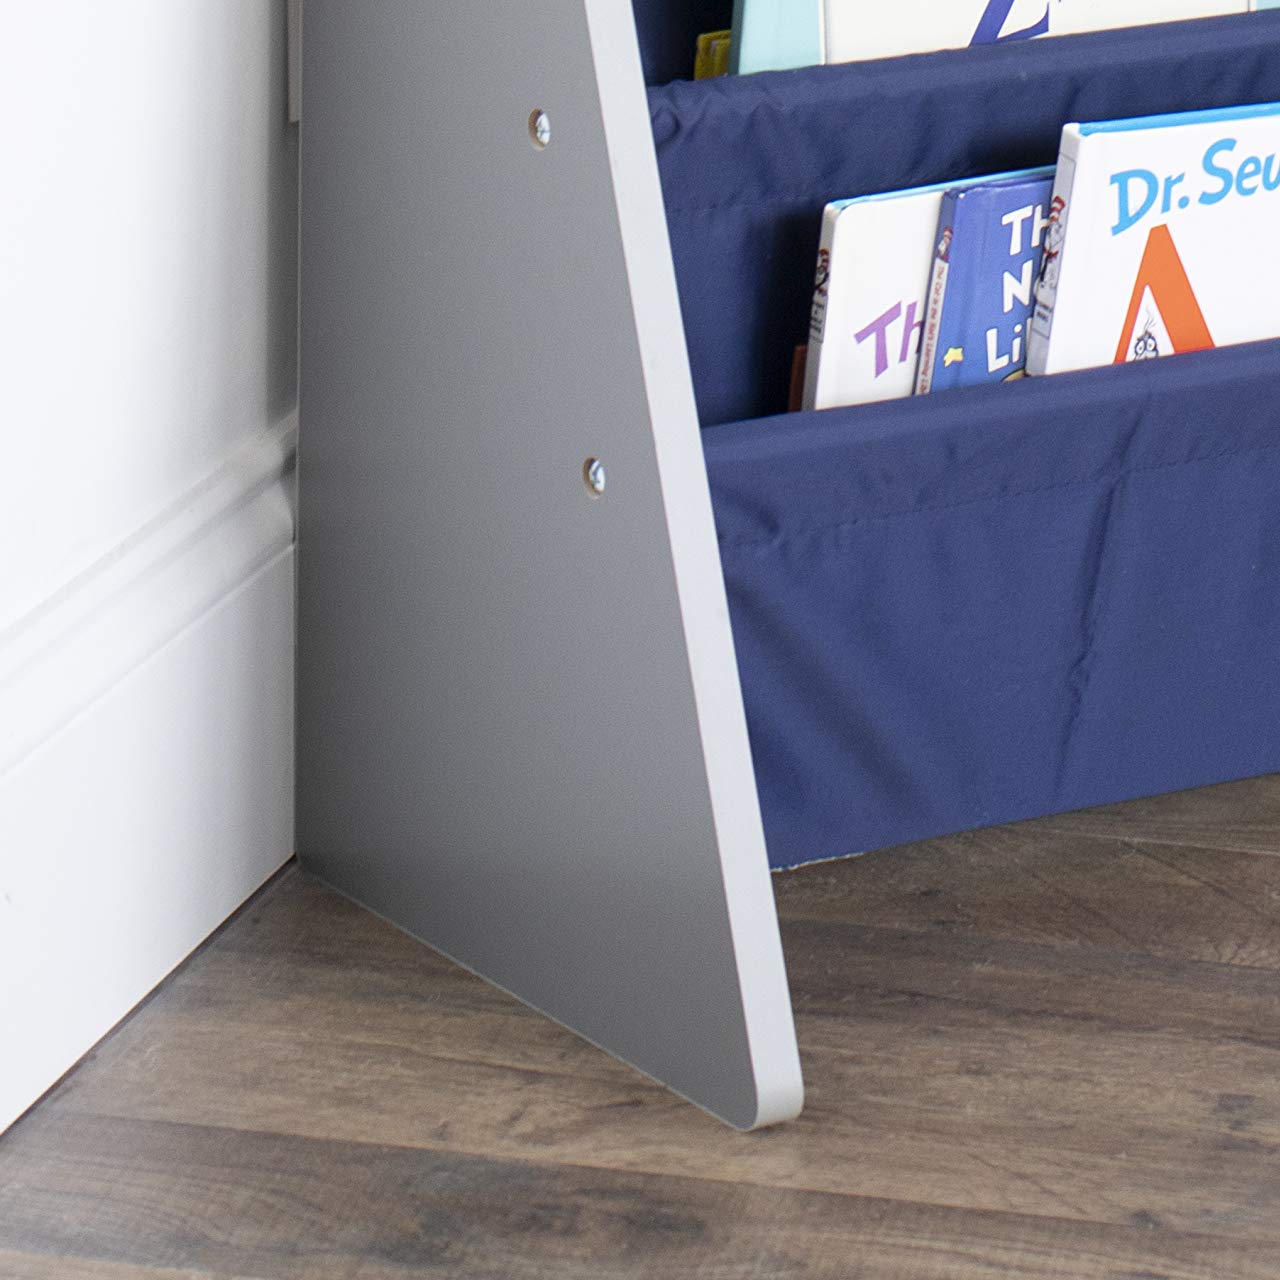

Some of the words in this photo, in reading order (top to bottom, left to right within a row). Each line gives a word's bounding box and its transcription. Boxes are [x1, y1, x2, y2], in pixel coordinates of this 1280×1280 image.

[1109, 168, 1190, 237] Dr.
[1003, 259, 1036, 314] N
[1113, 223, 1216, 364] A
